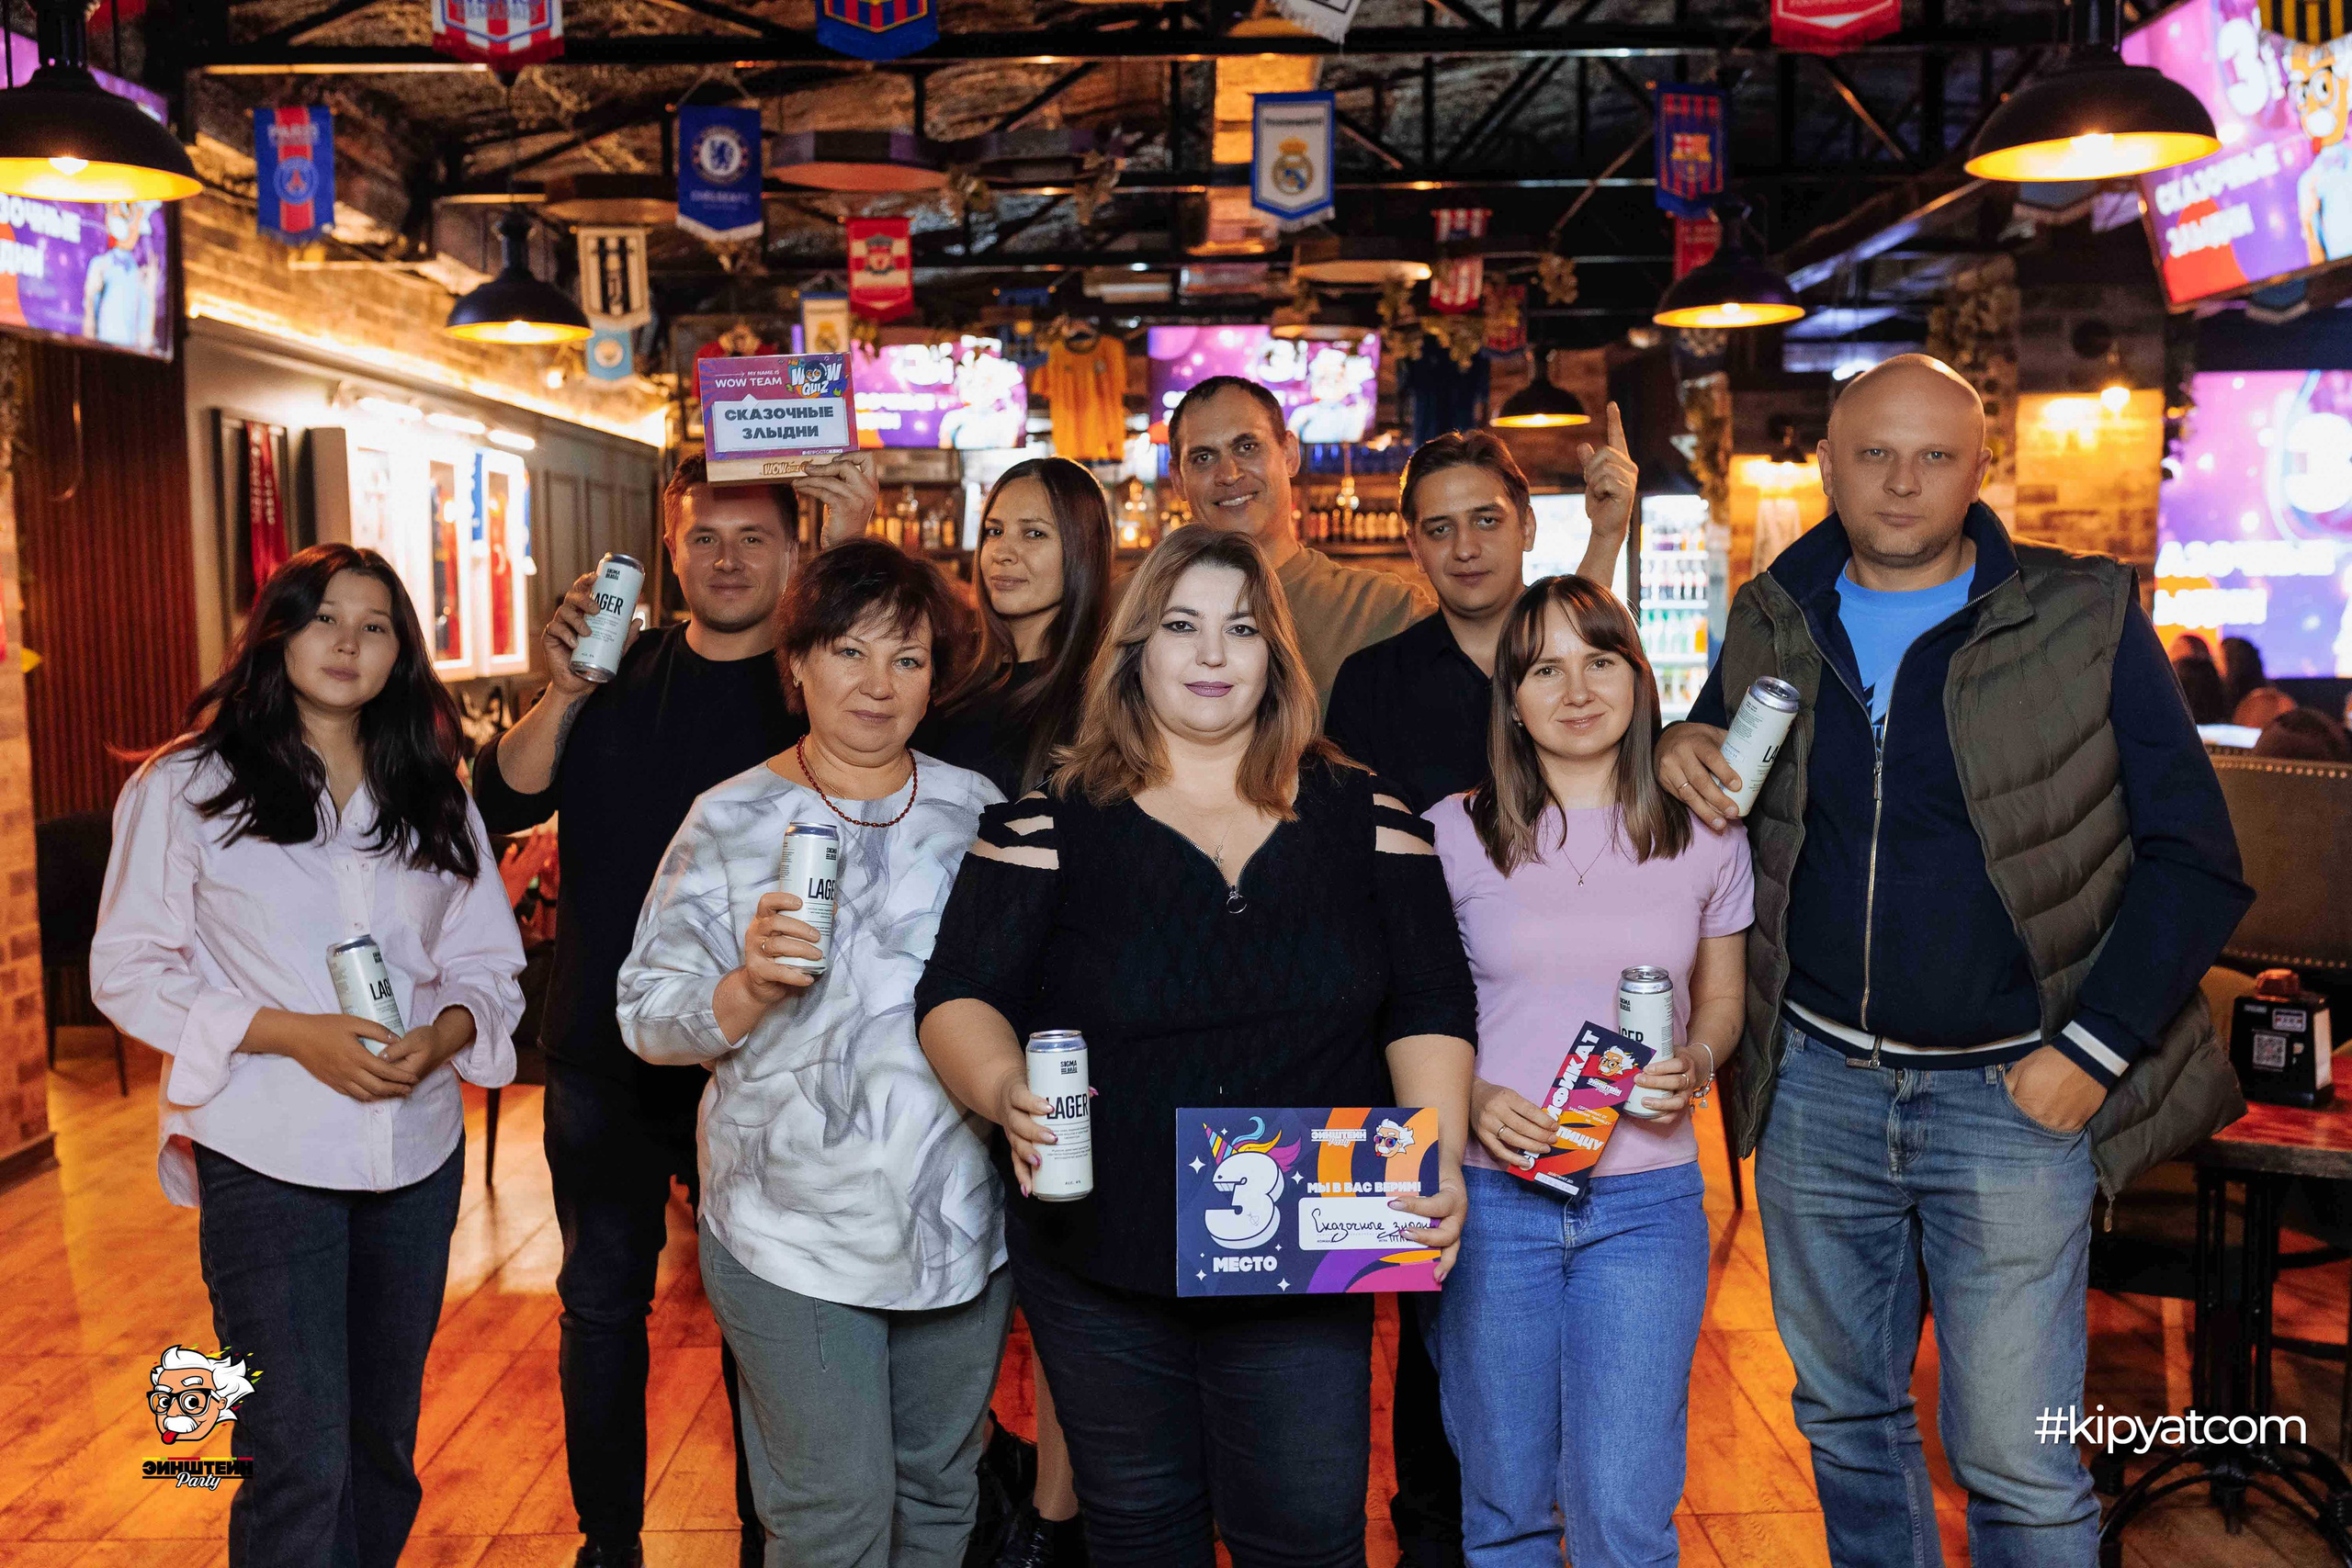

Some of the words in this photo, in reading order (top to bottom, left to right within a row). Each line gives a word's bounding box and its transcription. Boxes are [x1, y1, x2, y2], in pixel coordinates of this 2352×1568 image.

[715, 378, 747, 389] WOW
[750, 376, 783, 387] TEAM
[801, 380, 830, 397] QUIZ
[725, 405, 834, 422] СКАЗОЧНЫЕ
[742, 424, 820, 440] ЗЛЫДНИ
[1046, 1092, 1089, 1120] LAGER
[1556, 1126, 1605, 1151] ПИЦЦУ
[1307, 1182, 1330, 1194] МЫ
[1332, 1181, 1341, 1193] В
[1344, 1181, 1373, 1193] ВАС
[1374, 1181, 1422, 1193] ВЕРИМ!
[1204, 1151, 1285, 1250] 3
[1213, 1255, 1278, 1273] МЕСТО
